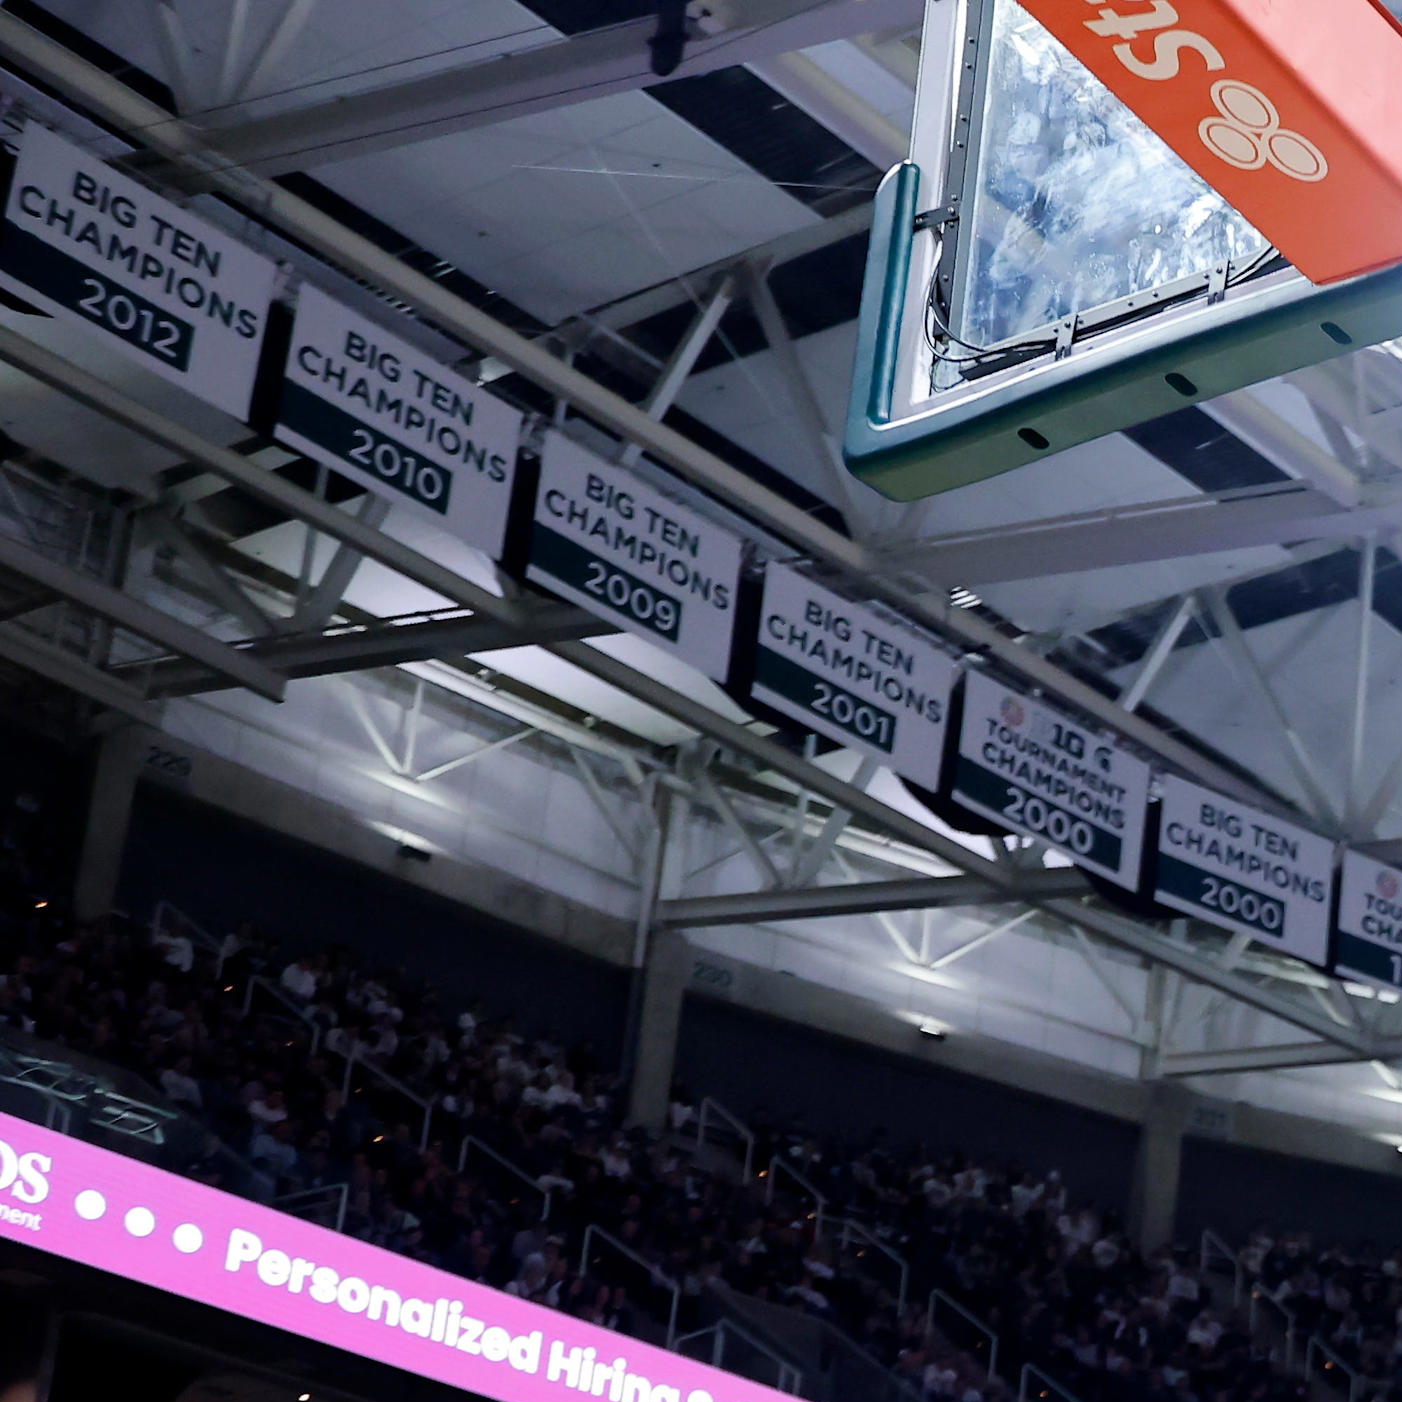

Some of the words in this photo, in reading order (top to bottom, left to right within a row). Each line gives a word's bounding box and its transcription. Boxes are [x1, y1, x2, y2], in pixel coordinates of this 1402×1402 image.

[19, 184, 258, 341] CHAMPIONS
[73, 170, 137, 230] BIG
[152, 215, 221, 276] TEN
[79, 278, 181, 358] 2012
[297, 344, 508, 484] CHAMPIONS
[347, 330, 402, 381] BIG
[412, 368, 474, 424] TEN
[348, 428, 444, 501] 2010
[544, 488, 729, 610] CHAMPIONS
[586, 473, 634, 520] BIG
[644, 507, 699, 558] TEN
[585, 562, 676, 632] 2009
[804, 601, 851, 642] BIG
[861, 629, 913, 674] TEN
[767, 614, 942, 724] CHAMPIONS
[811, 683, 891, 743] 2001
[982, 742, 1125, 830] CHAMPIONS
[985, 717, 1126, 804] TOURNAMENT
[1002, 787, 1095, 856] 2000
[1166, 822, 1325, 903] CHAMPIONS
[1200, 803, 1242, 839] BIG
[1250, 824, 1298, 862] TEN
[1200, 878, 1281, 931] 2000
[224, 1227, 543, 1376] Personalized
